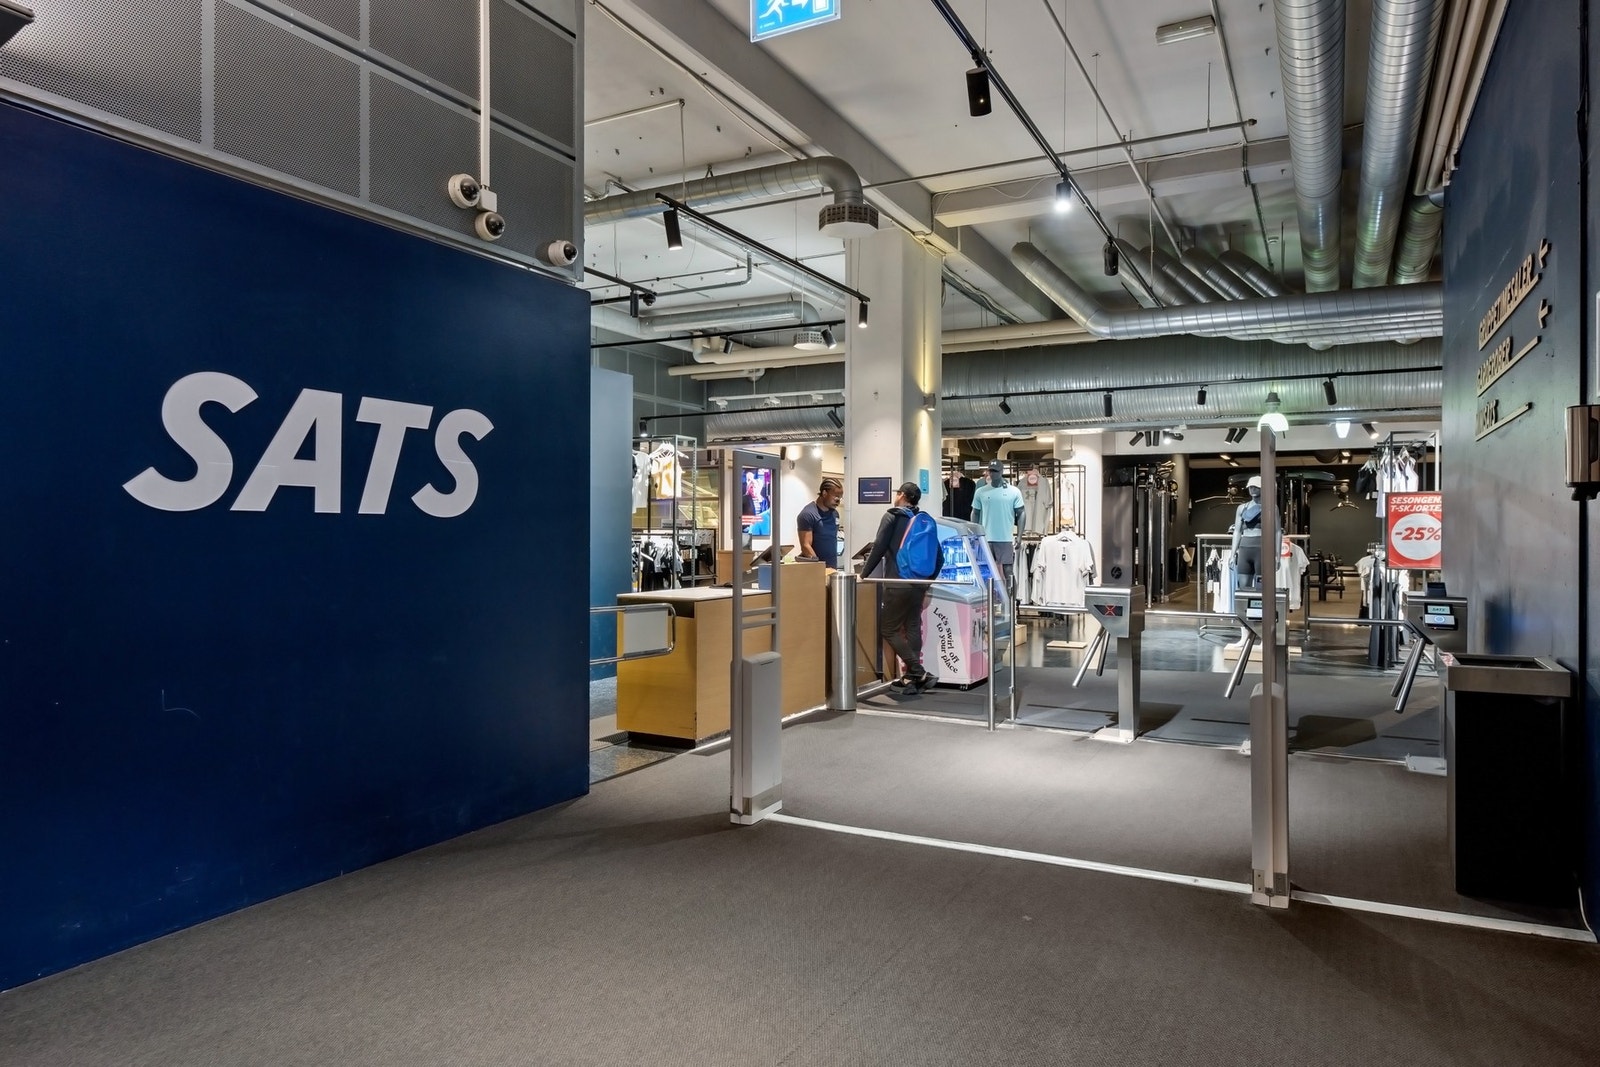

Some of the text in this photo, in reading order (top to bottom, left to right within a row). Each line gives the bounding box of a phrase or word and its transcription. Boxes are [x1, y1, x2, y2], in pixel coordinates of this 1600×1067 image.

[122, 371, 495, 518] SATS
[1391, 496, 1442, 504] SESONGEN
[1391, 504, 1442, 512] T-SKJORTE
[1395, 527, 1441, 541] -25%
[933, 607, 960, 664] Let's swirl off
[936, 622, 958, 673] to your place
